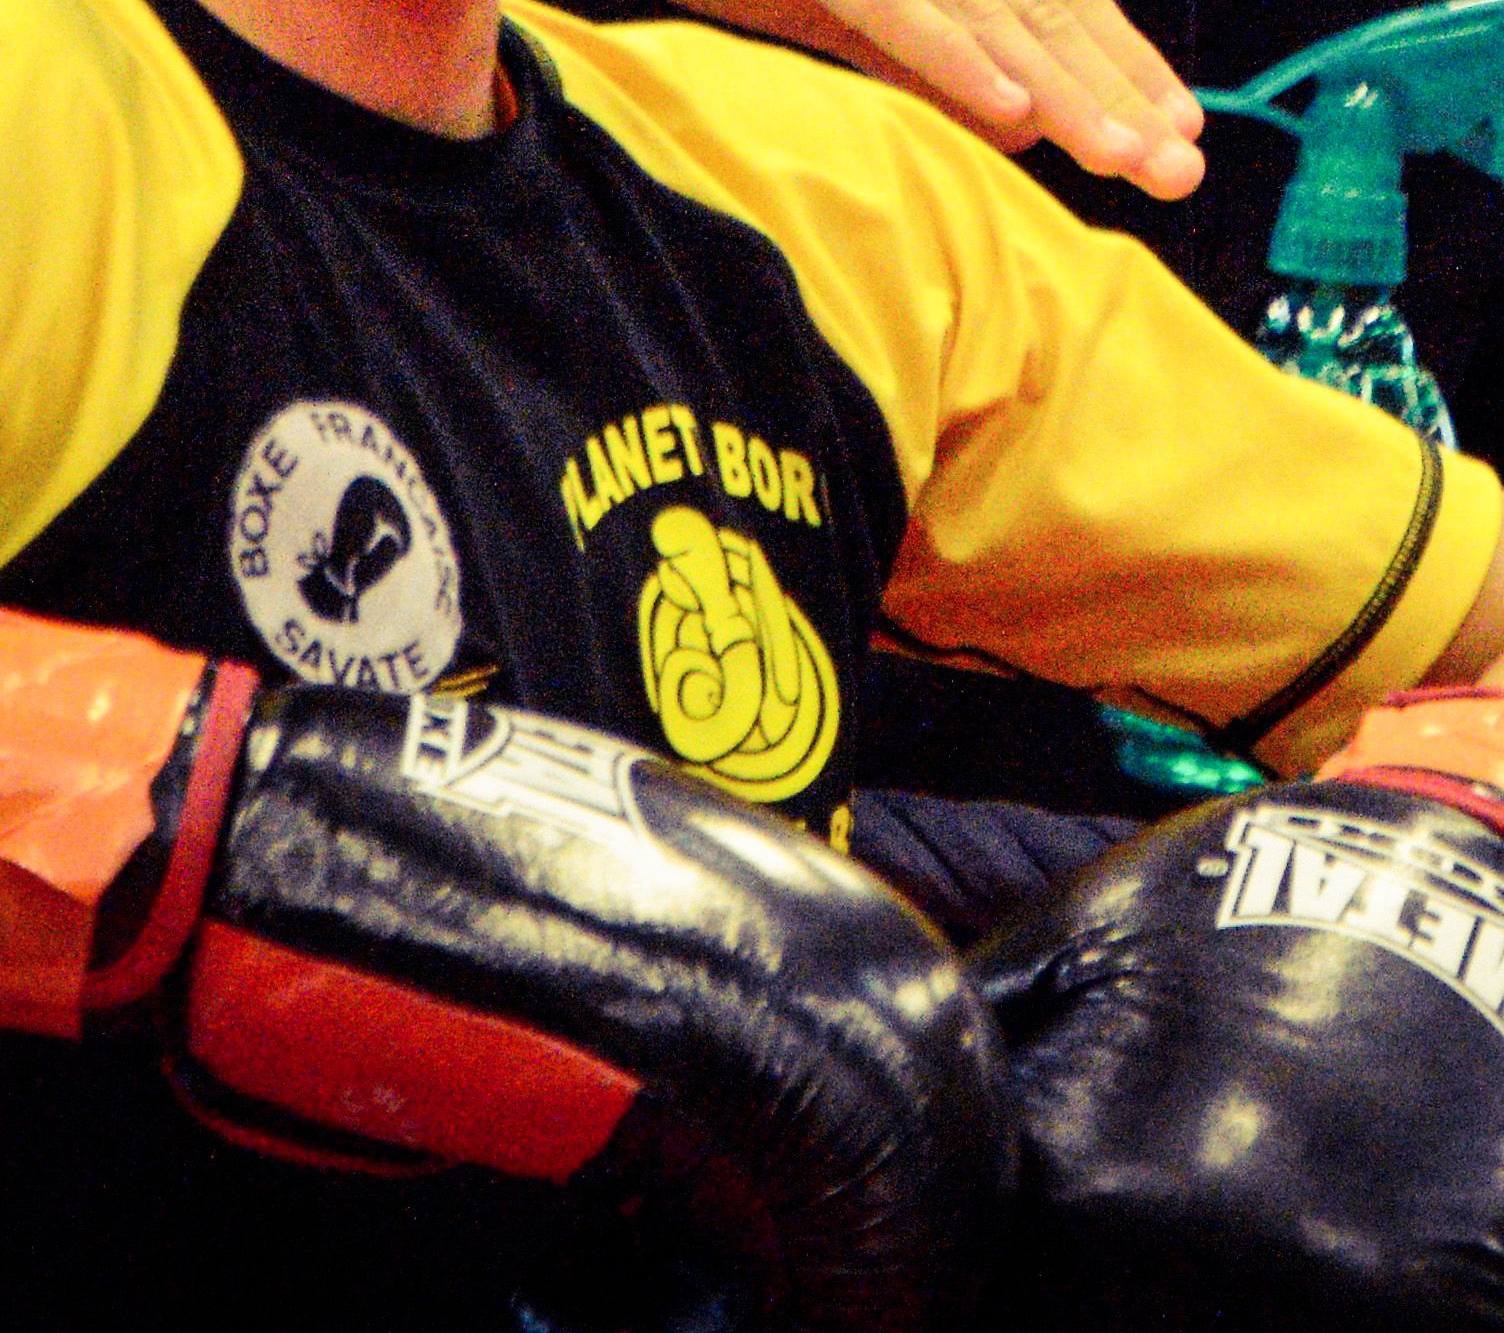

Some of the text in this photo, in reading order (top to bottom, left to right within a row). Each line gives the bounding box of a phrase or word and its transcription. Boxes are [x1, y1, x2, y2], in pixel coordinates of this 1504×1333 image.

[239, 439, 299, 578] BOXE
[560, 403, 828, 551] LANET BOR
[275, 618, 430, 690] SAVATE
